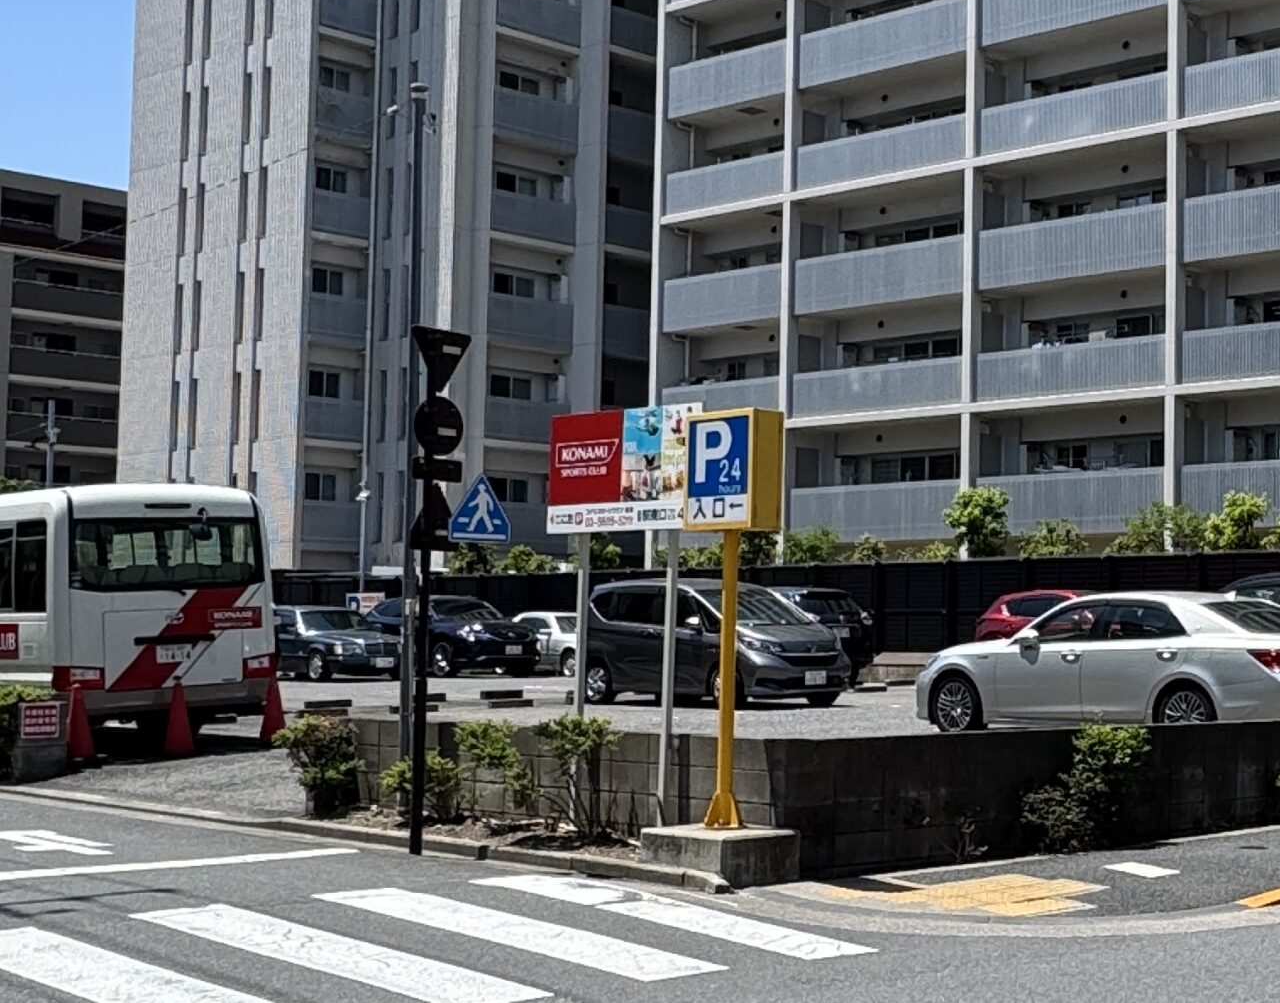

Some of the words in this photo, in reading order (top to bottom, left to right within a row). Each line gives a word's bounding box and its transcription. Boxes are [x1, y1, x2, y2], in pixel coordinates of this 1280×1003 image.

[561, 446, 608, 462] KONAMI
[694, 421, 732, 483] P
[718, 457, 741, 483] 24
[693, 498, 725, 520] 入口
